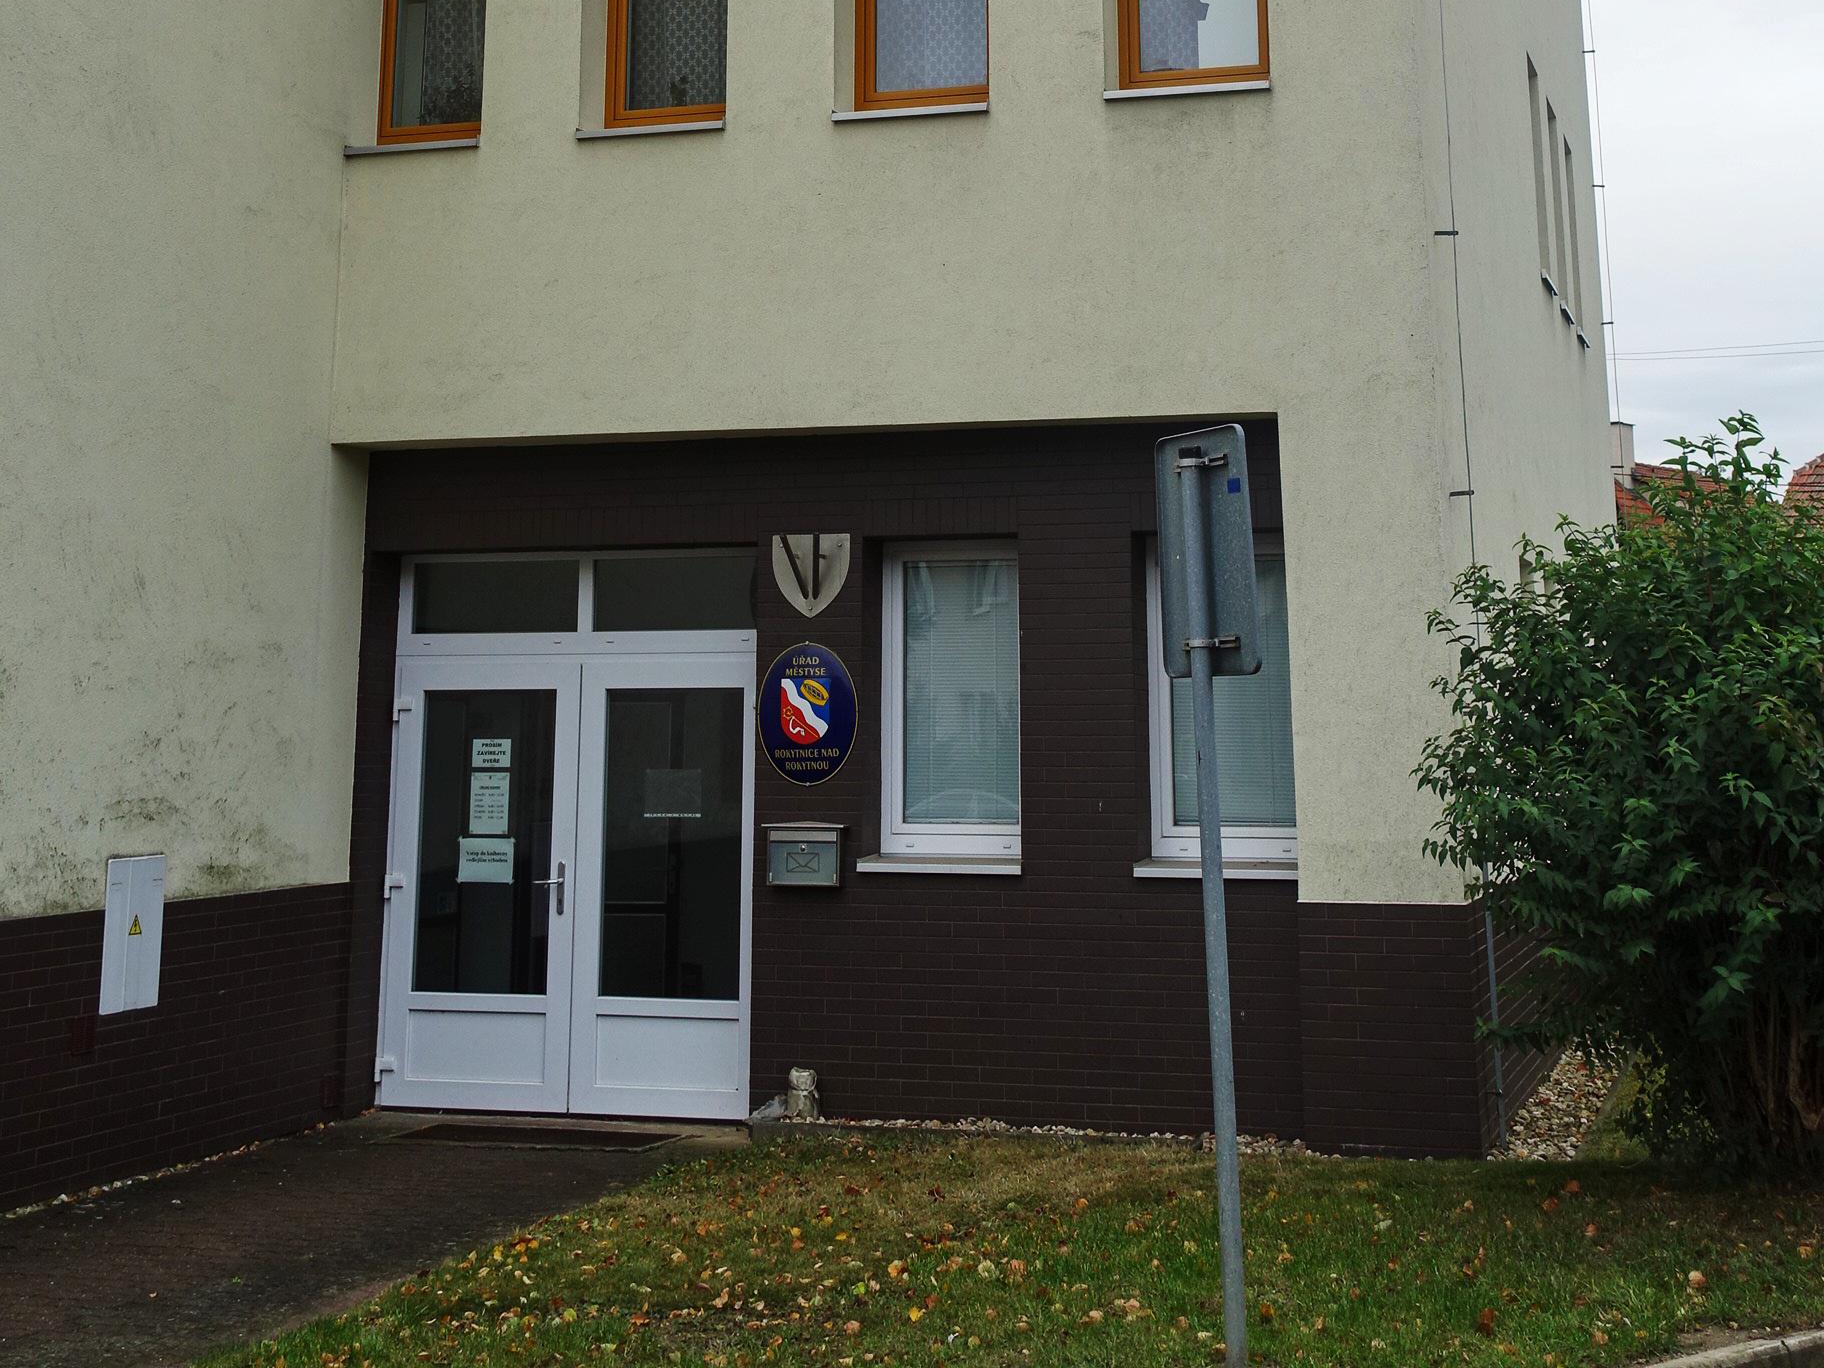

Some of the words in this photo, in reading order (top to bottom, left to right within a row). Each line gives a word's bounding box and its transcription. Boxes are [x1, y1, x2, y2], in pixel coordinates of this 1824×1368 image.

[792, 655, 820, 666] ÚŘAD
[785, 667, 826, 677] MĚSTYSE
[774, 749, 819, 759] ROKYTNICE
[821, 748, 840, 757] NAD
[785, 761, 830, 771] ROKYTNOU
